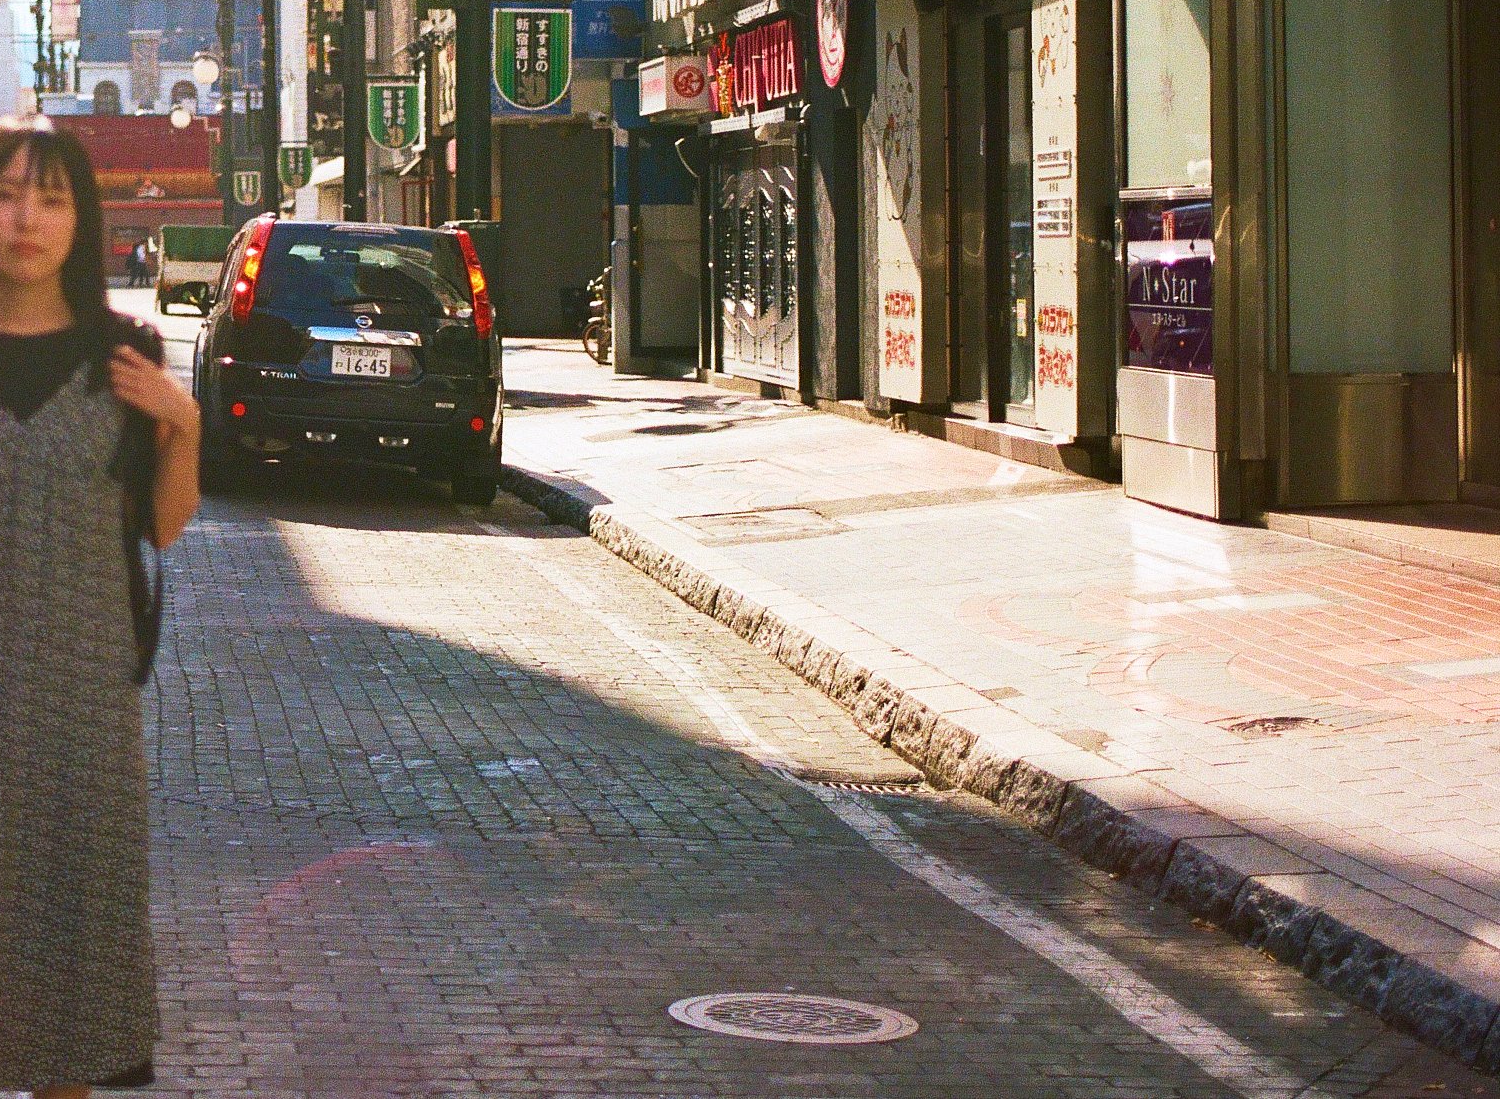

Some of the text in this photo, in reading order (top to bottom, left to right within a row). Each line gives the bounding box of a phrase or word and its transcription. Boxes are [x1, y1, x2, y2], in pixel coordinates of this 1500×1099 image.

[515, 18, 530, 73] 新宿通り
[535, 19, 549, 73] すすきの
[346, 357, 387, 374] 16-45
